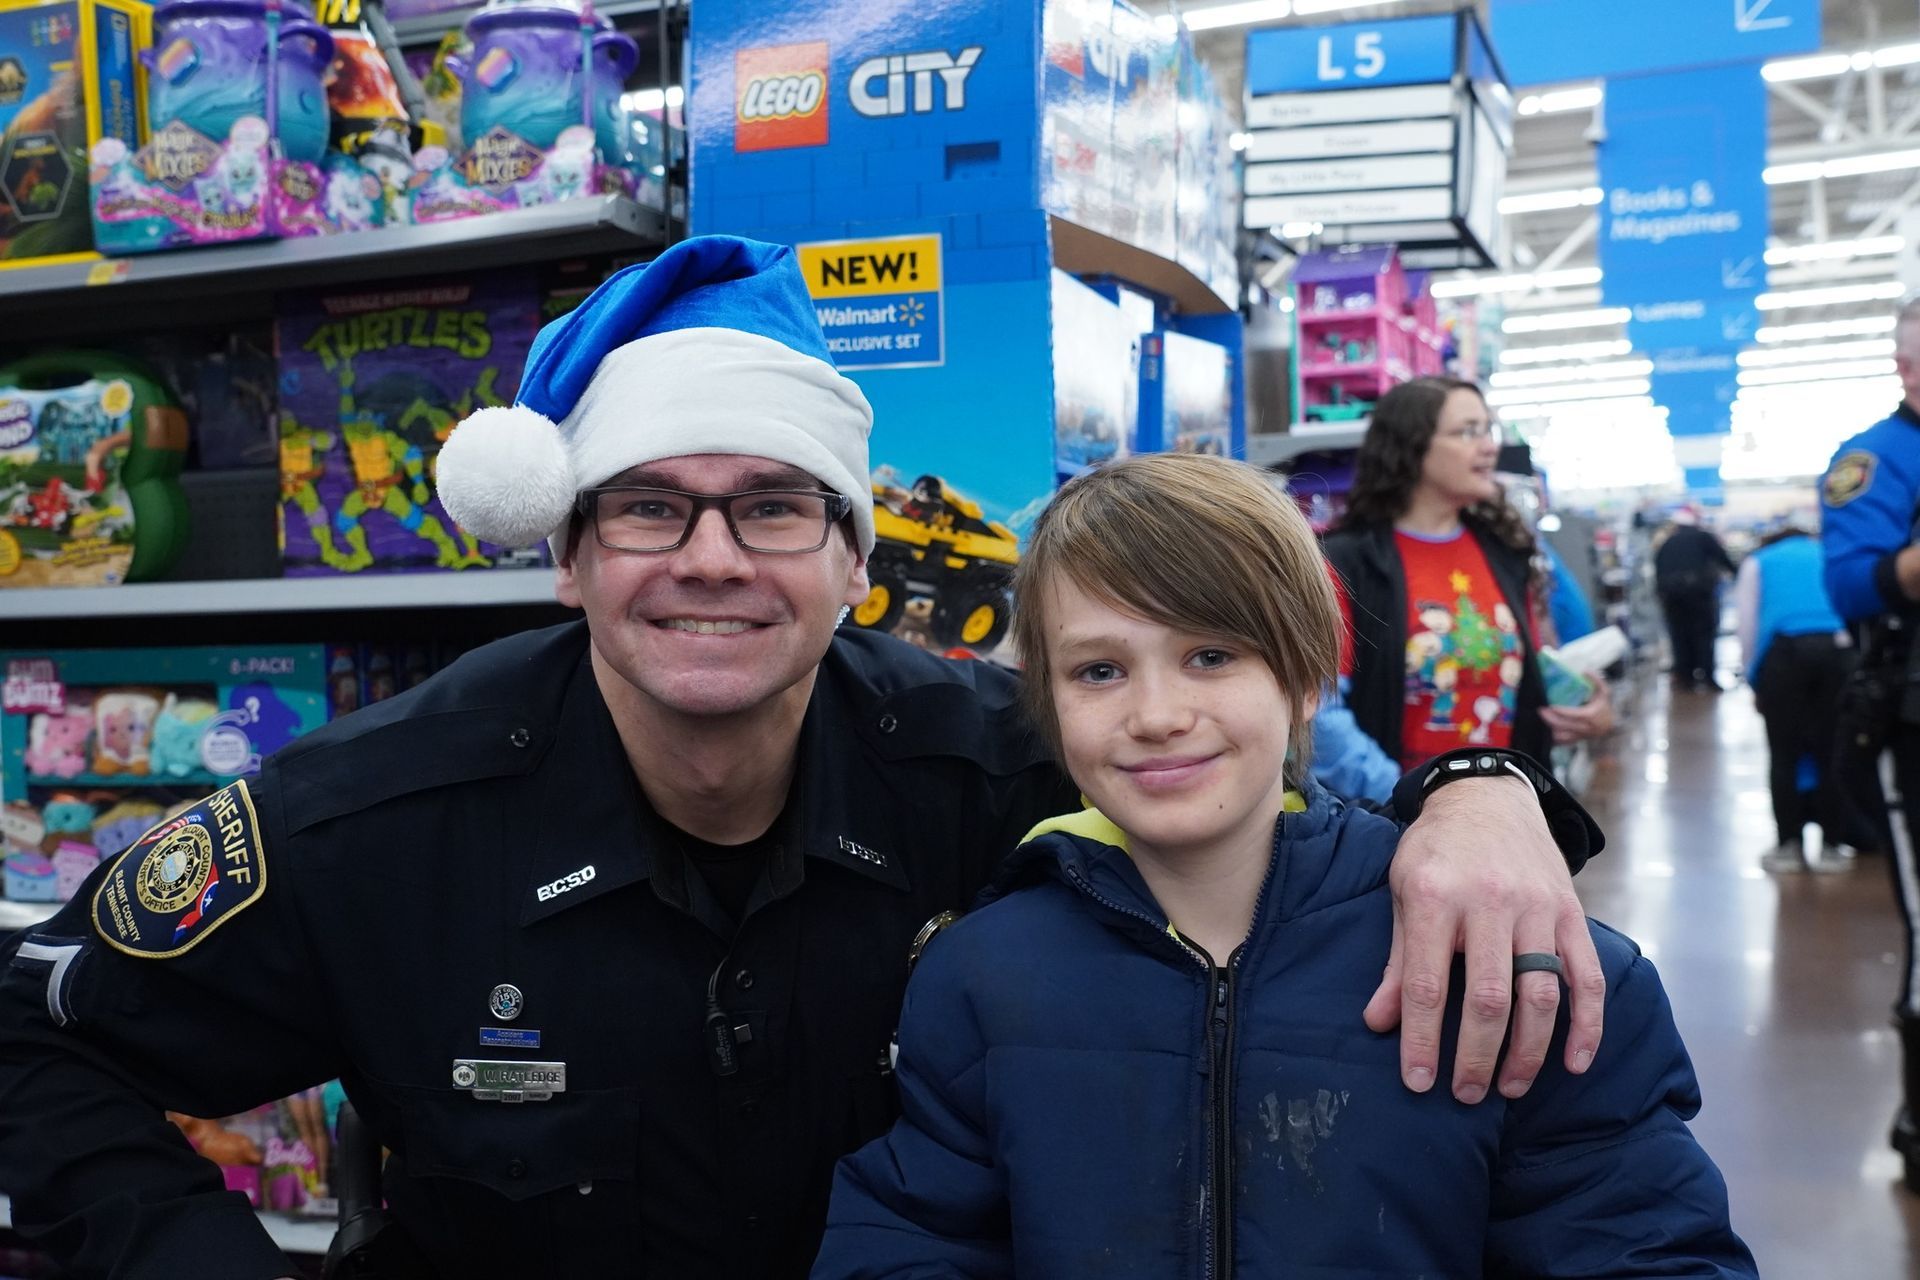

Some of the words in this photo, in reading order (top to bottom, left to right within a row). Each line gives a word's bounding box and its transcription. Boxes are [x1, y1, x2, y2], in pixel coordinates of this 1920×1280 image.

[1317, 35, 1346, 81] L
[1354, 31, 1386, 78] 5
[742, 74, 823, 118] LEGO
[849, 46, 984, 119] CITY
[1610, 187, 1689, 214] Books
[1691, 180, 1714, 207] &
[1610, 211, 1741, 243] Magazines
[820, 251, 919, 287] NEW!
[817, 304, 897, 327] Walmart
[303, 307, 493, 373] TURTLES
[826, 335, 893, 352] XCLUSIVE
[895, 333, 921, 349] SET
[181, 826, 208, 845] BLOUNT
[208, 790, 251, 884] SHERIFF
[194, 845, 212, 891] COUNTY
[536, 864, 596, 902] BCSO
[105, 885, 127, 939] TENNESSEE
[115, 869, 129, 905] BLOUNT
[122, 903, 141, 942] COUNTY
[144, 895, 176, 911] OFFICE
[500, 992, 510, 1001] 15
[500, 1070, 561, 1084] RATLEDGE
[263, 1136, 315, 1167] Barbie
